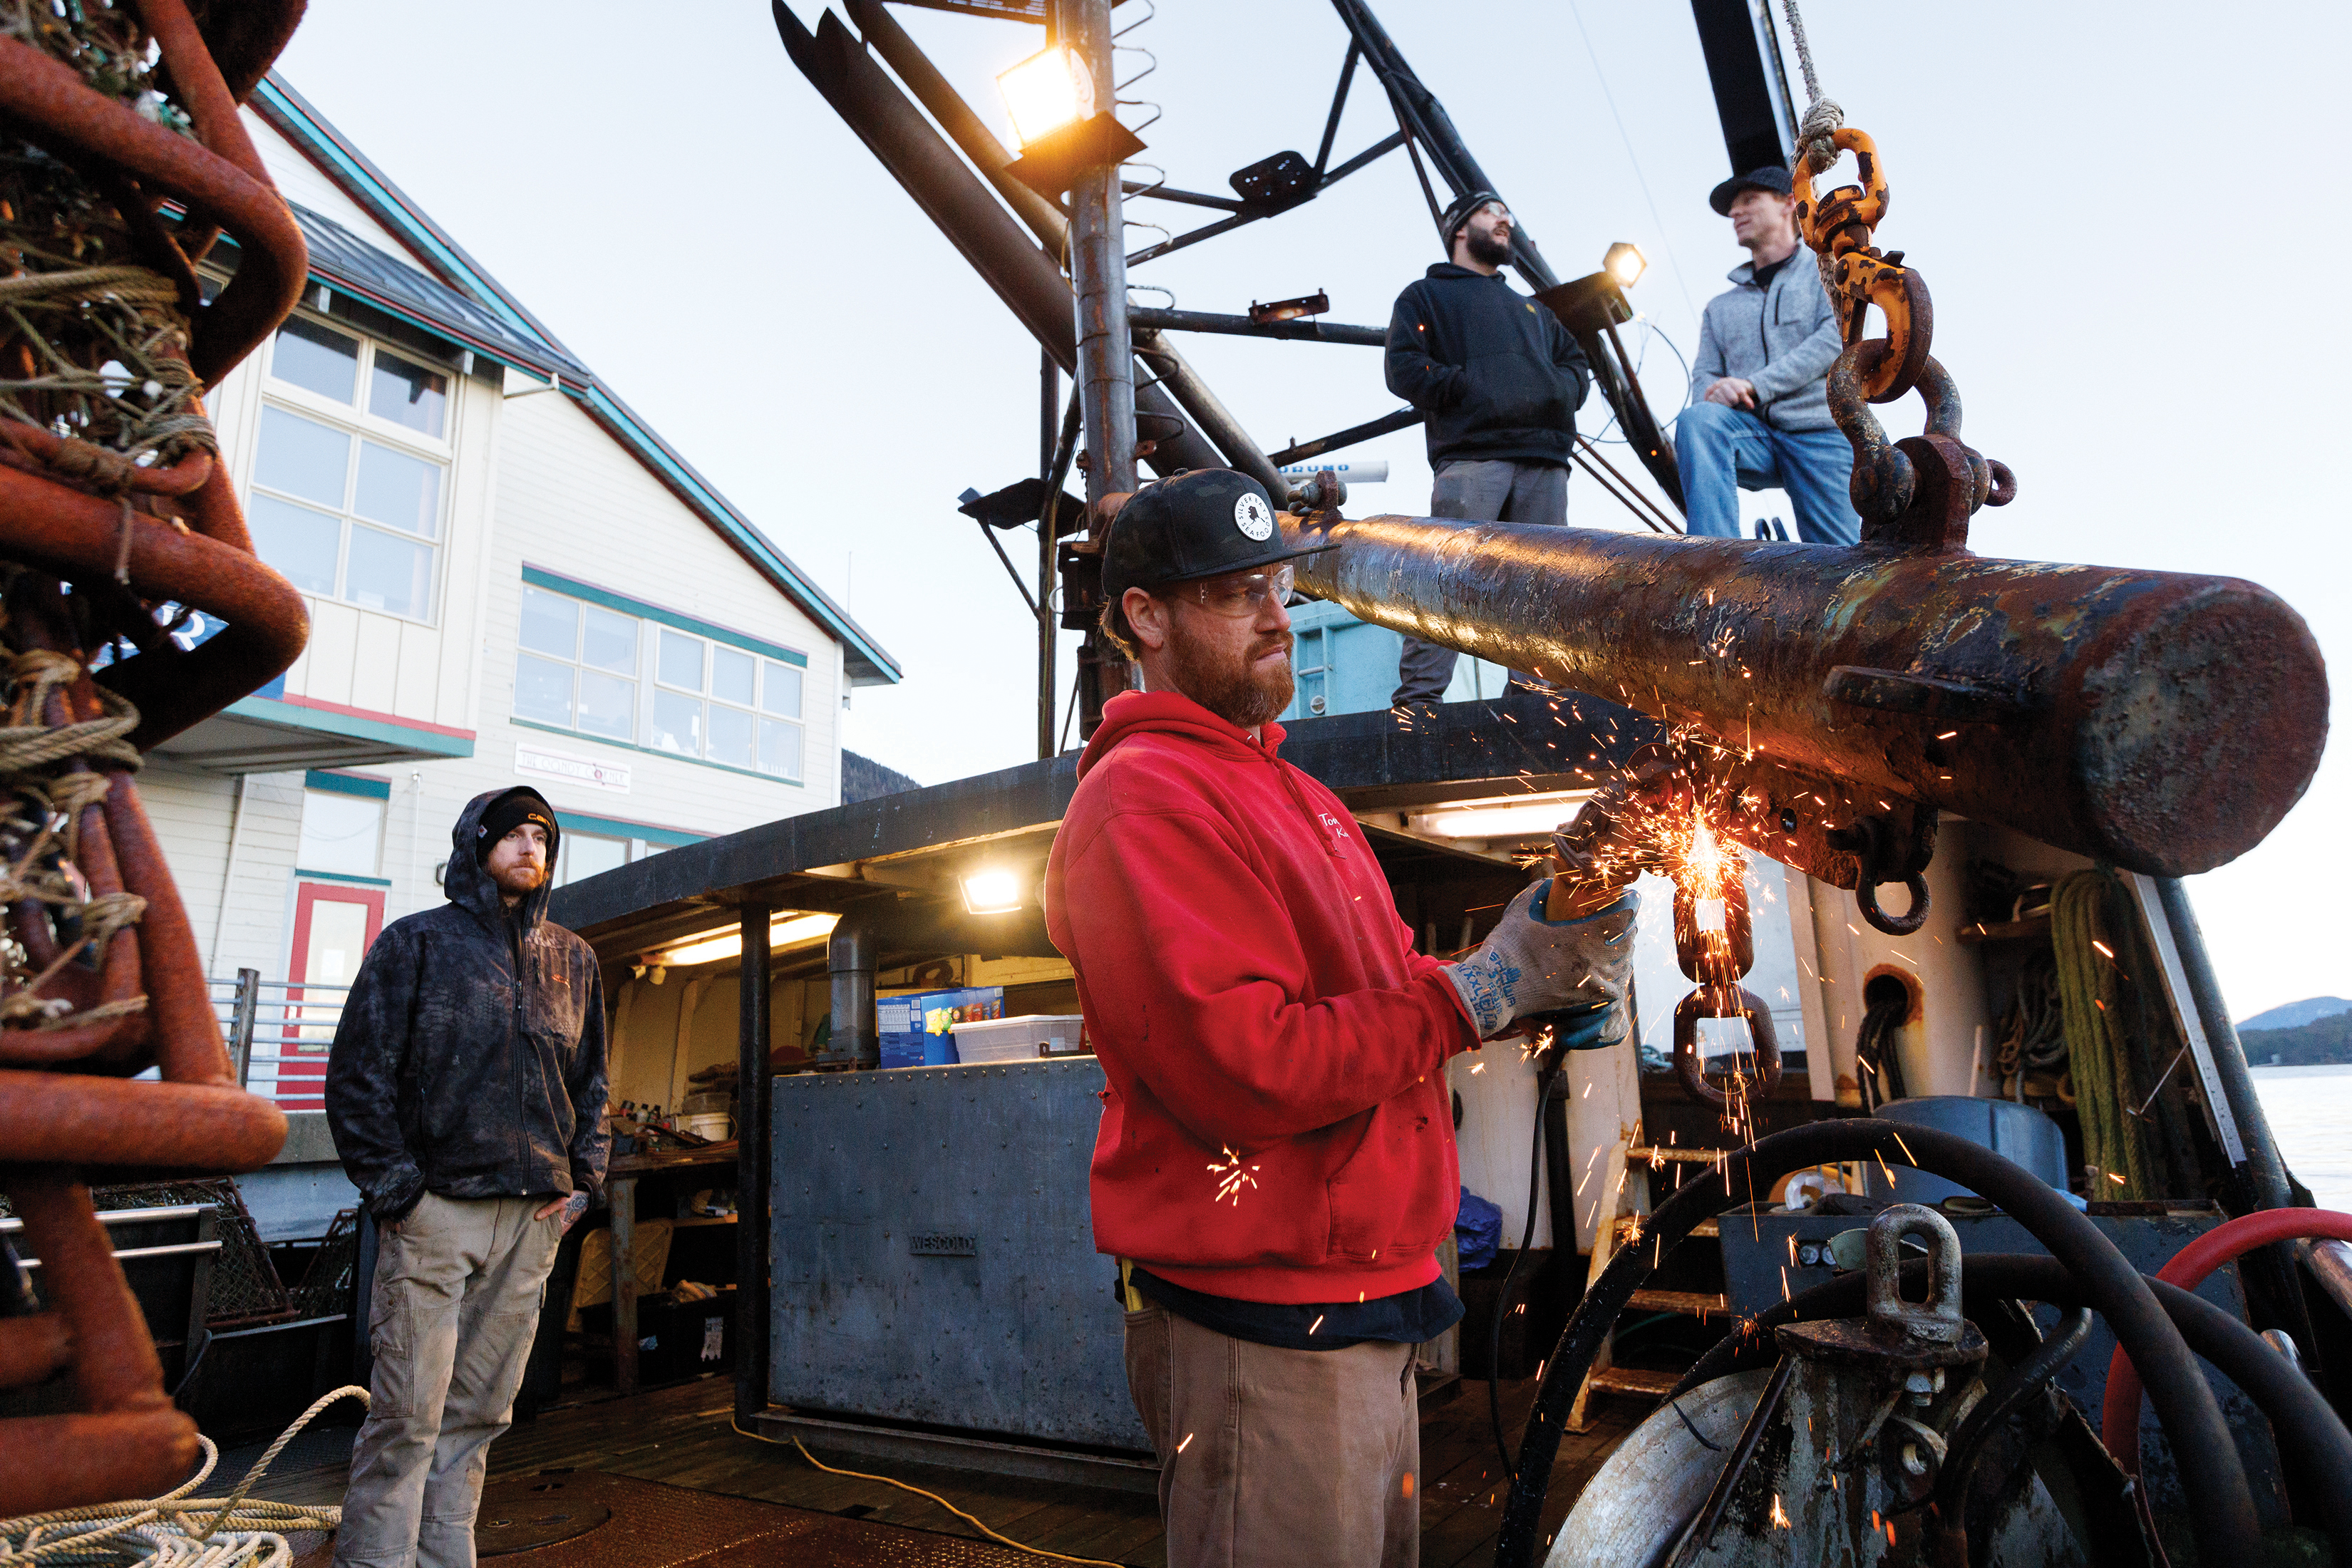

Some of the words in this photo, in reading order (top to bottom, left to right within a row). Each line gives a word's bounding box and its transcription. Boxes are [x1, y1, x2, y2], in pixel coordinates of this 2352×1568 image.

[1278, 464, 1349, 473] URUNO
[1238, 496, 1252, 520] SILVER
[1254, 497, 1267, 512] BAY
[1242, 515, 1270, 537] SEAFOODS
[522, 754, 537, 767] THE
[542, 758, 582, 775] CANDY
